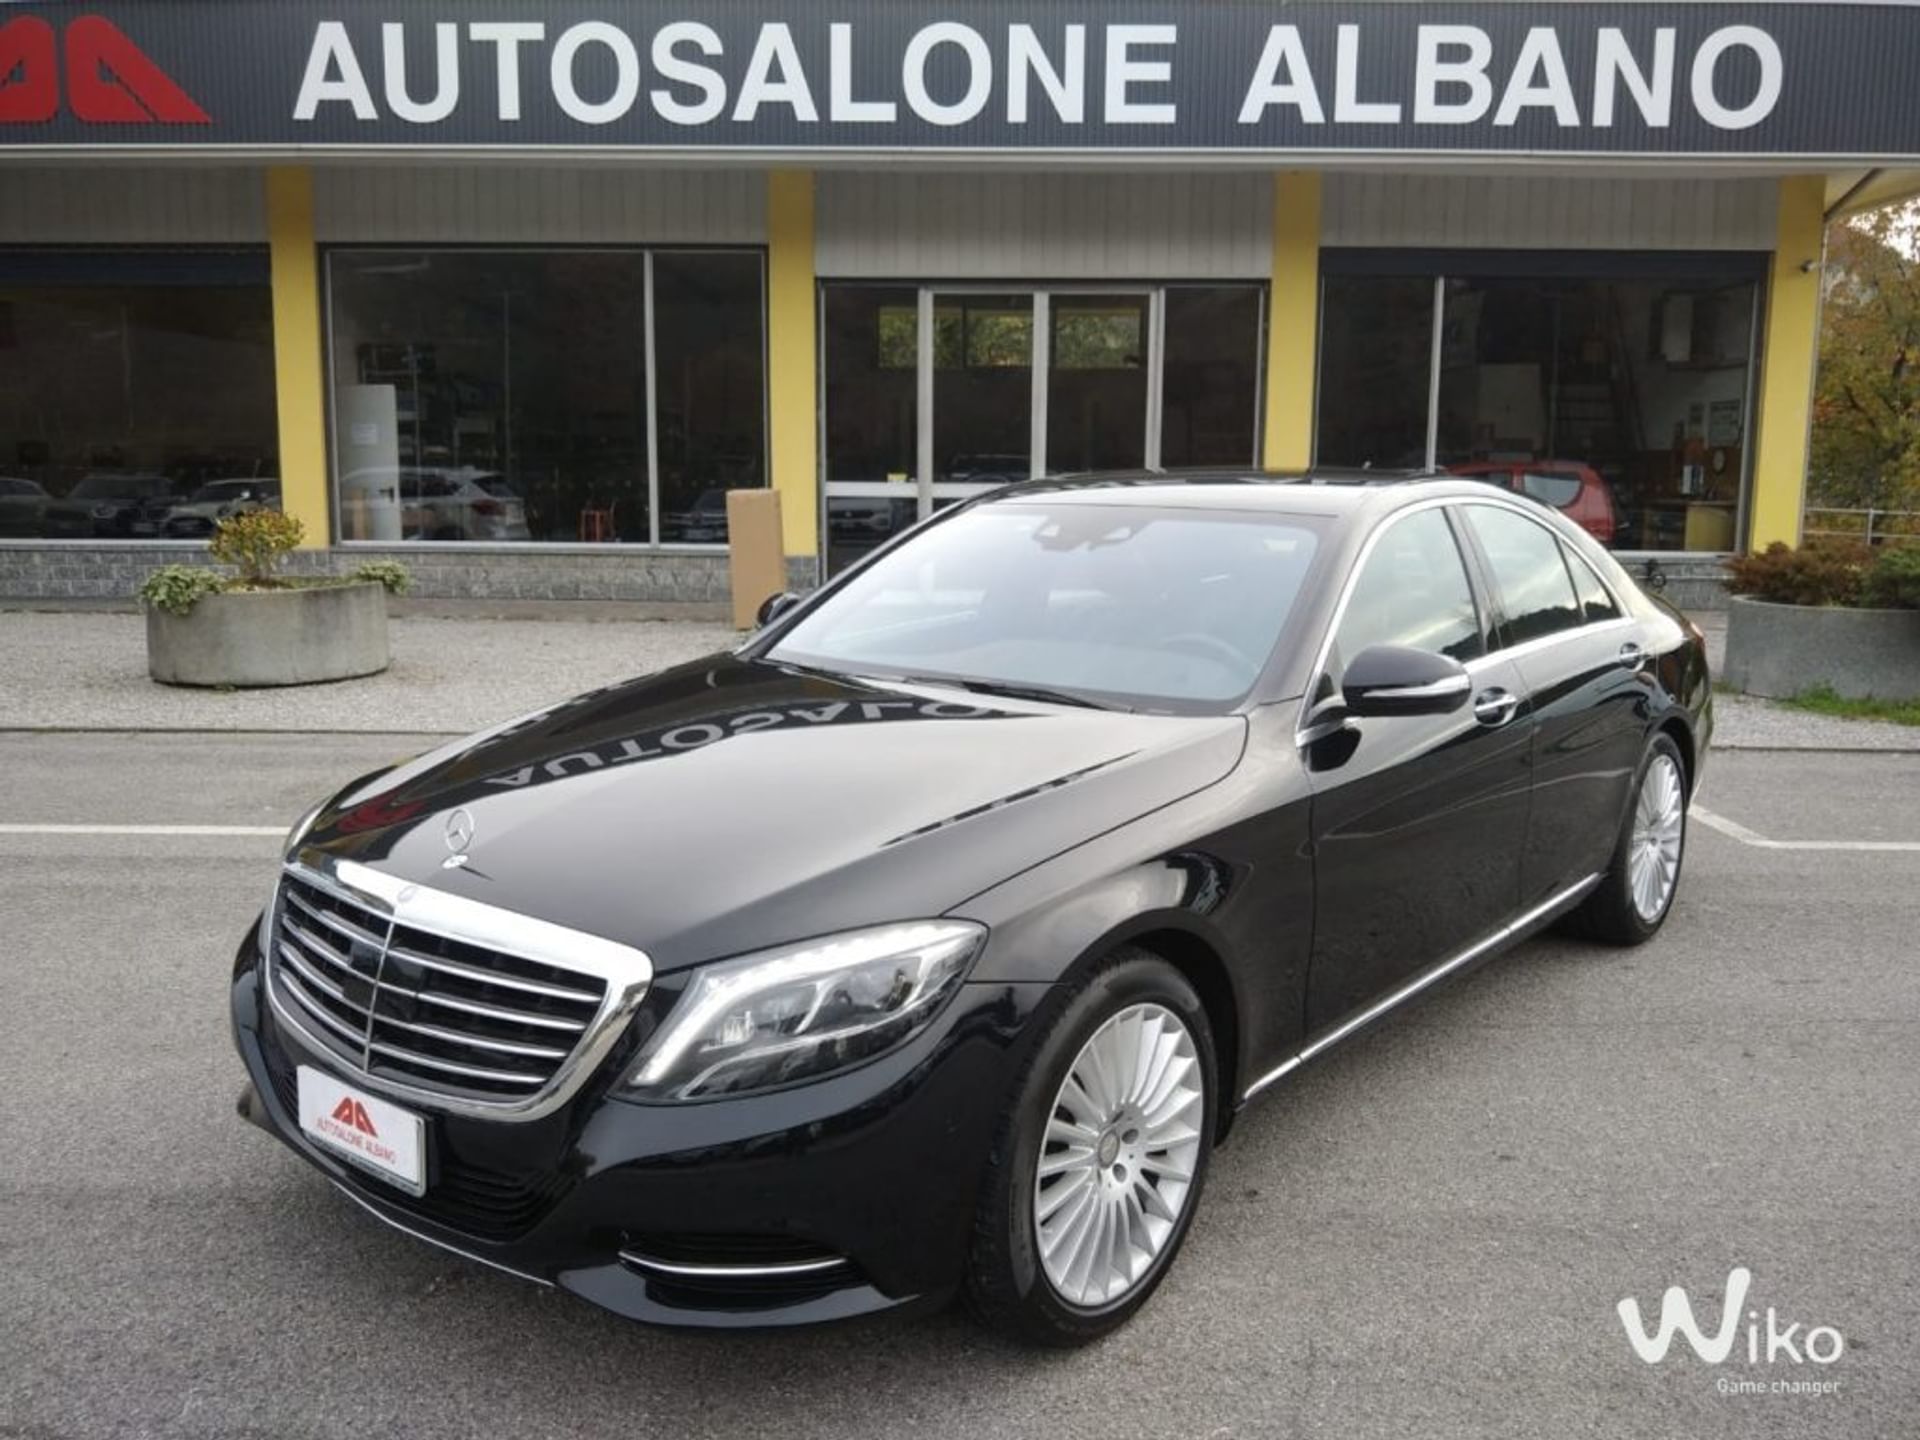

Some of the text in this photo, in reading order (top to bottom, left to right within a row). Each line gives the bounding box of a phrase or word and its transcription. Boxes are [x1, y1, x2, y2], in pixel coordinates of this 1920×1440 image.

[293, 20, 1783, 130] AUTOSALONE ALBANO
[317, 1117, 397, 1165] AUTOSALONE ALBANO
